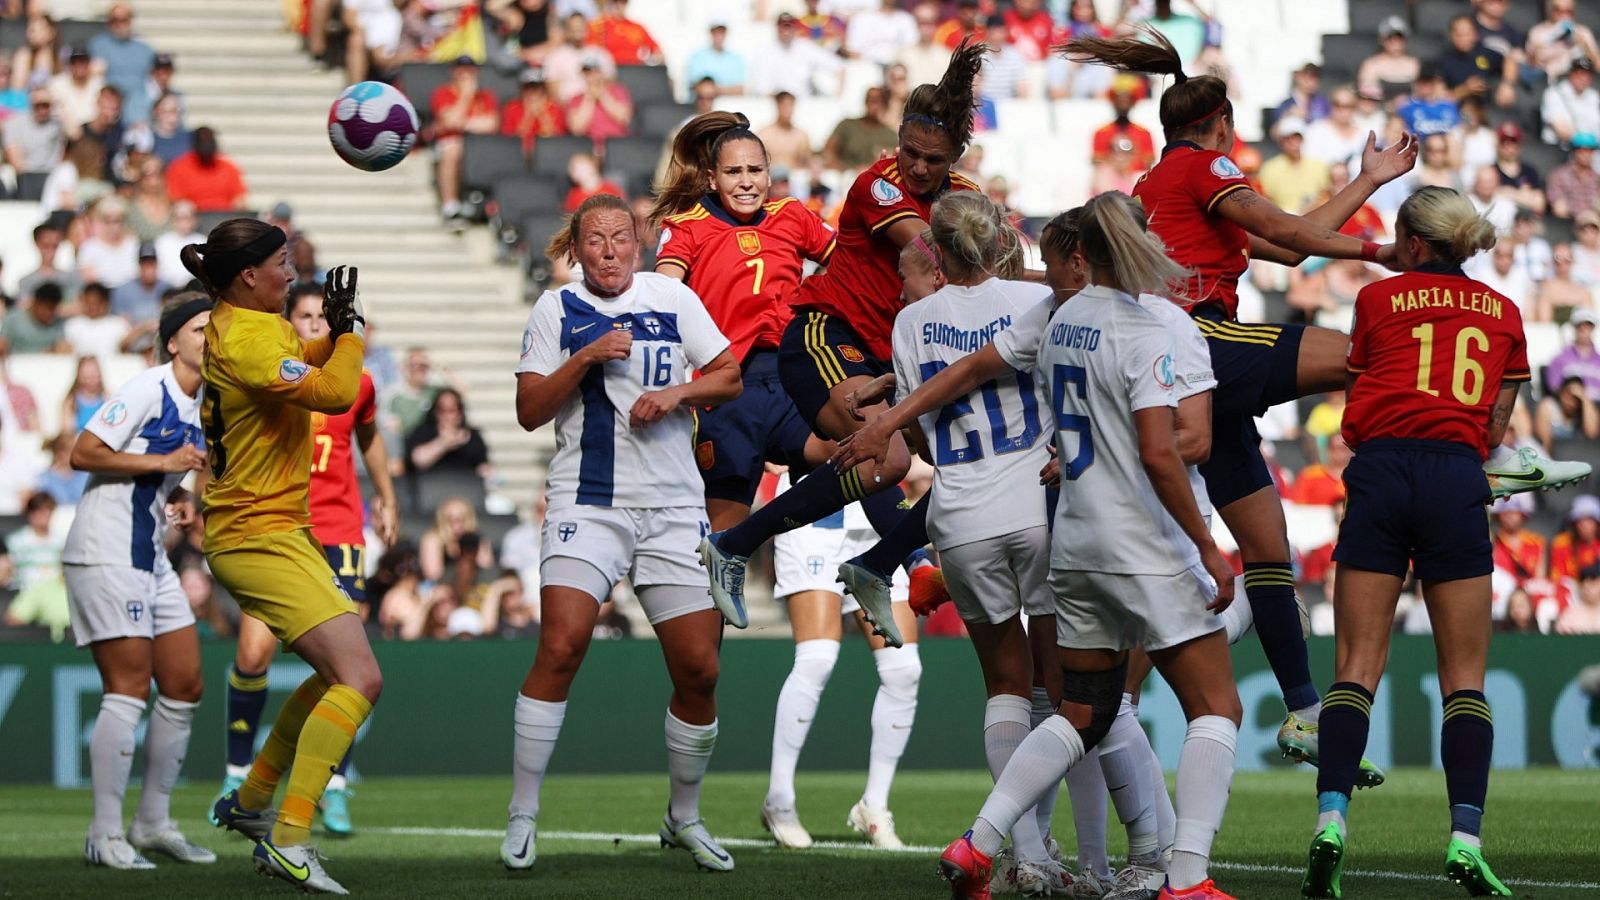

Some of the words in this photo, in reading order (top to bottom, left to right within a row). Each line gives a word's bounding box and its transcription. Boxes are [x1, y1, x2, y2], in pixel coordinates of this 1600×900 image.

[745, 257, 765, 295] 7
[1459, 291, 1503, 320] LEÓN
[922, 314, 1012, 353] SUMMANEN
[1050, 322, 1101, 352] KOIVISTO
[642, 346, 672, 387] 16
[1411, 322, 1490, 407] 16
[311, 434, 334, 473] 7
